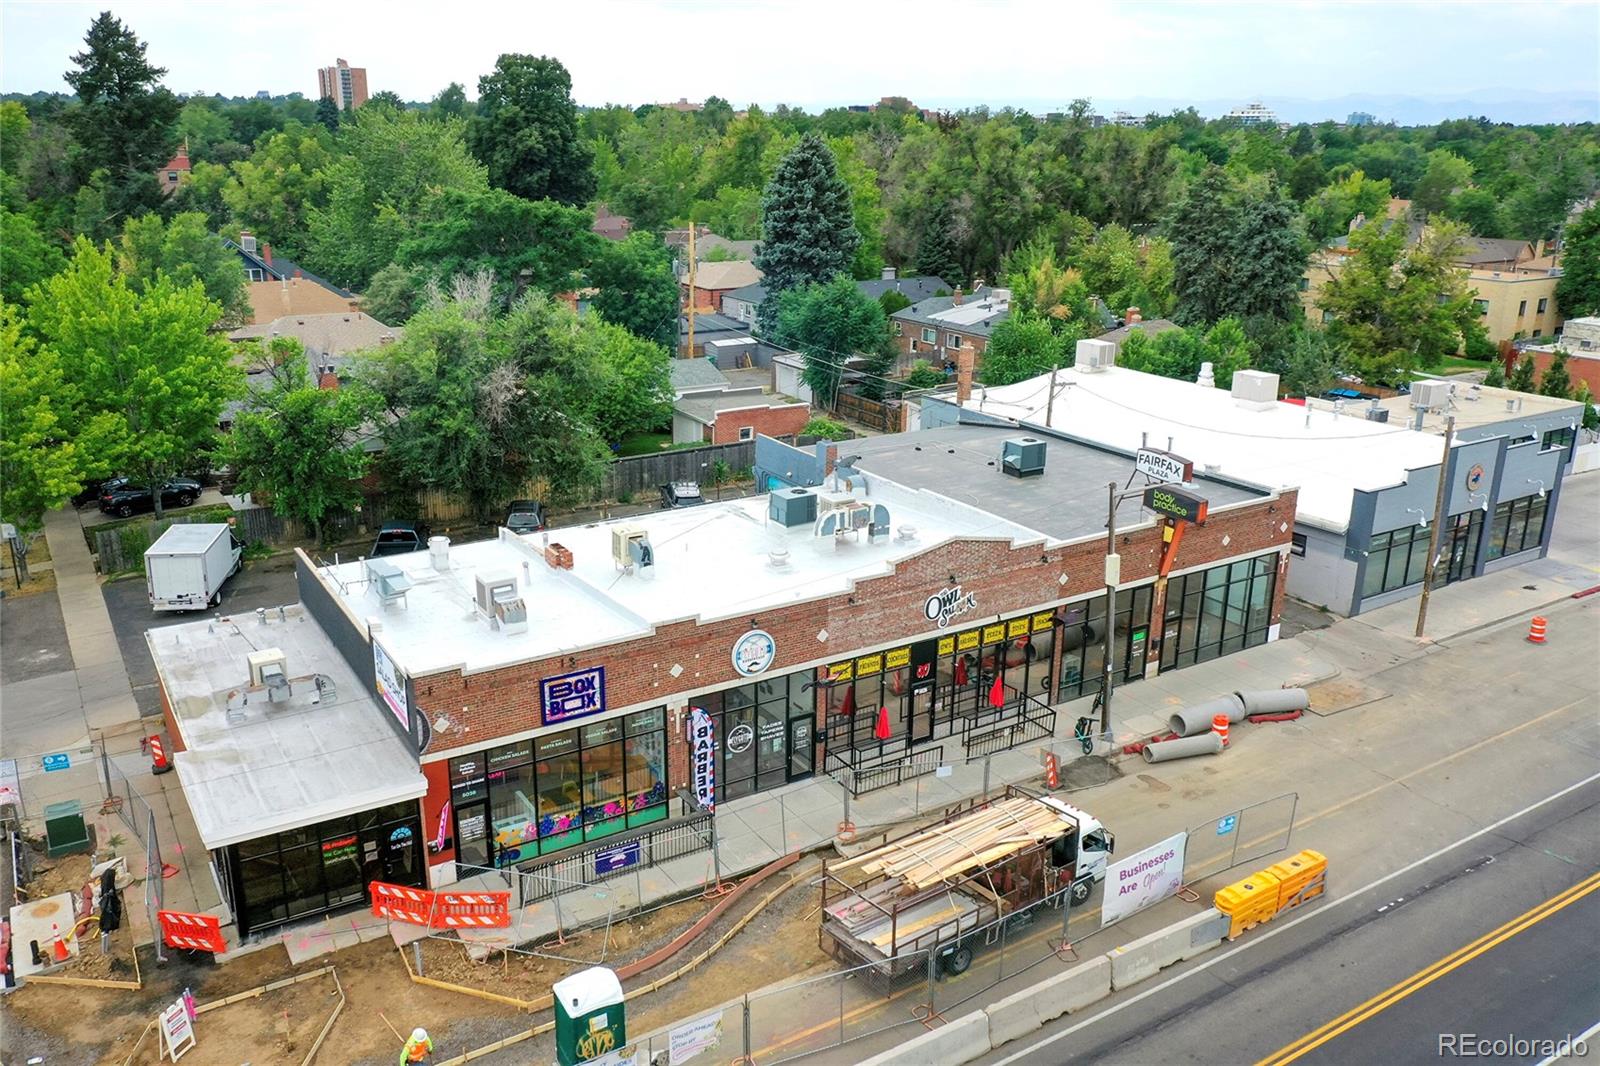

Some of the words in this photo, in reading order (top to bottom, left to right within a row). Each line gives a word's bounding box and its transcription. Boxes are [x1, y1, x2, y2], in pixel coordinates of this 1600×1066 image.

[1138, 454, 1181, 477] FAIRFAX
[1148, 466, 1169, 479] PLAZA
[1153, 489, 1175, 505] body
[1153, 499, 1187, 517] practice
[549, 675, 596, 700] BOX
[490, 754, 512, 763] CHICKEN
[511, 749, 530, 758] SALADS
[1119, 849, 1175, 881] Businesses
[1118, 882, 1138, 896] Are
